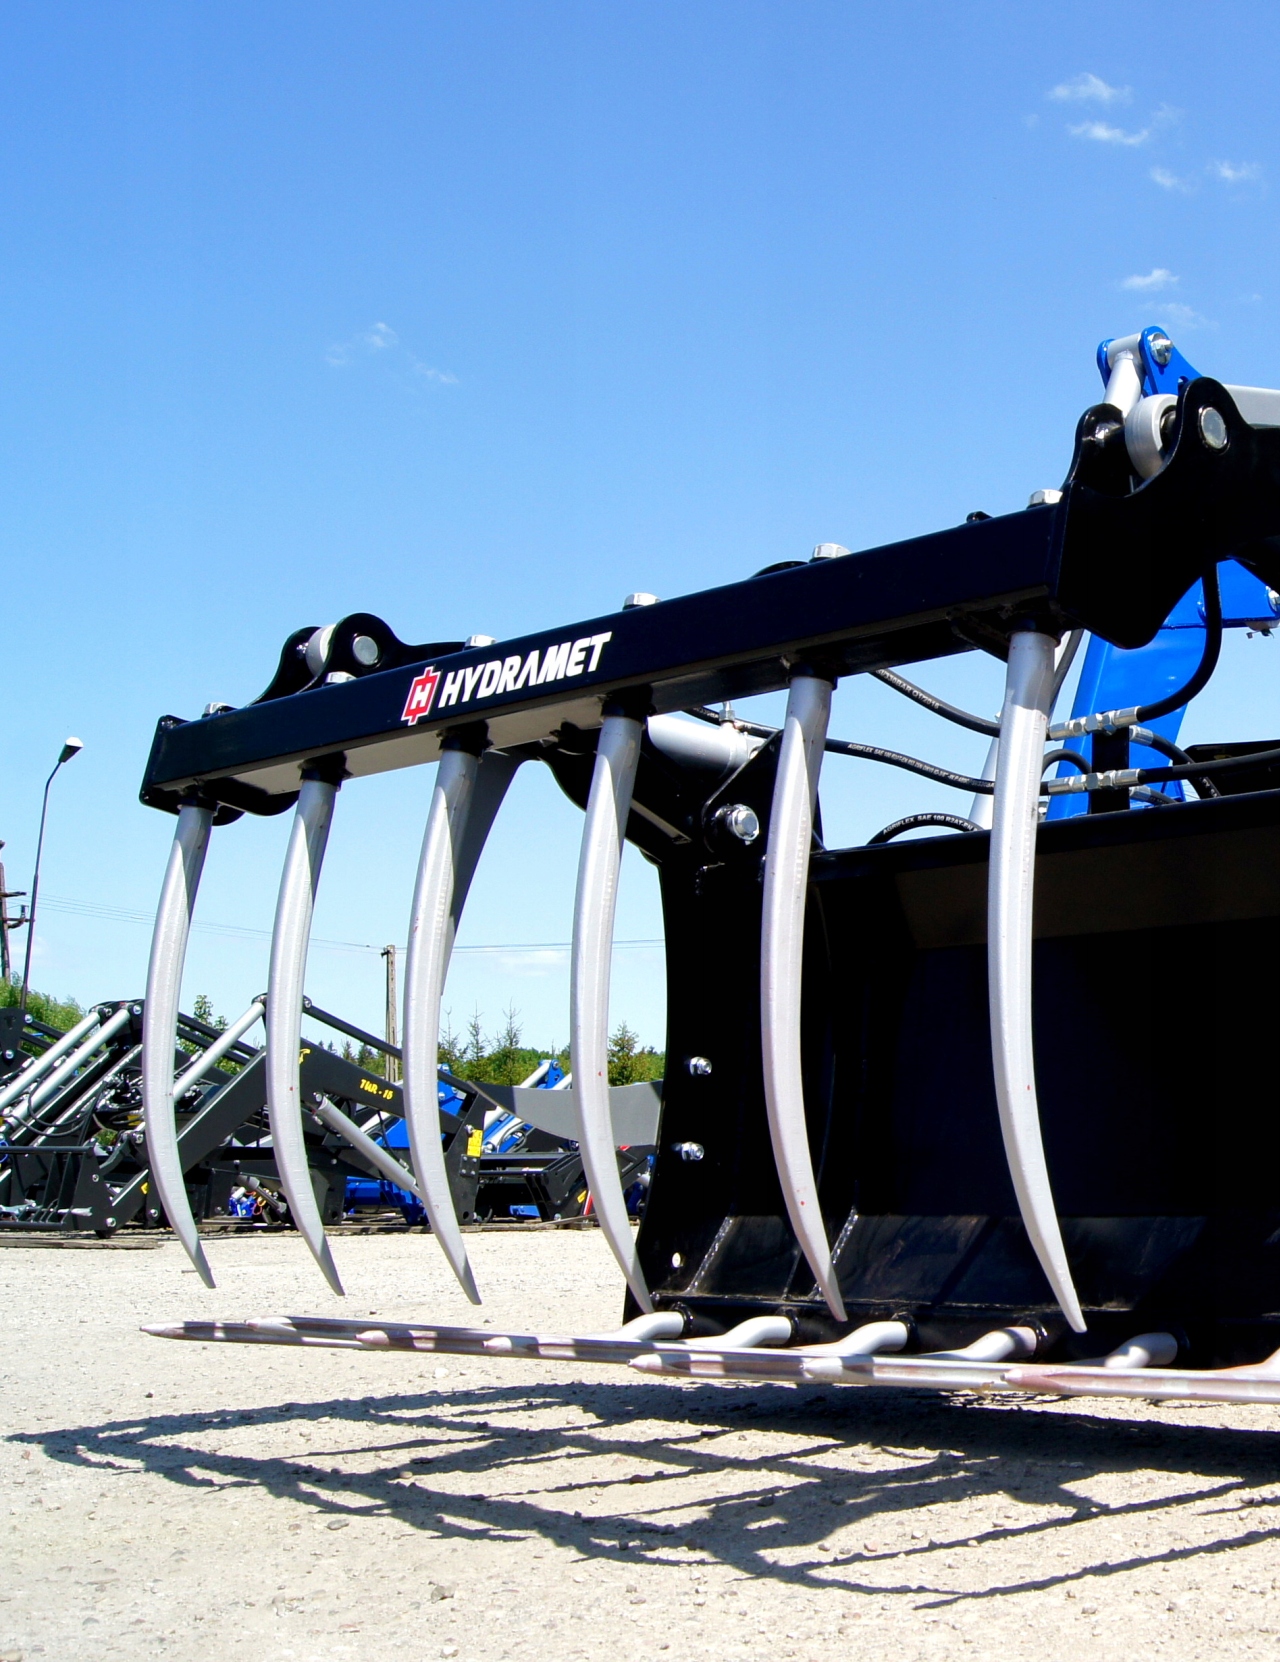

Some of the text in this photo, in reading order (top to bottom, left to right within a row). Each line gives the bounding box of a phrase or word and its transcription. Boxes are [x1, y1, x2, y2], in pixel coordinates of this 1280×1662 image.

[438, 632, 612, 709] HYDRAMET
[883, 817, 915, 836] AGRIFLEX
[917, 814, 933, 822] SAE
[933, 814, 945, 822] 100
